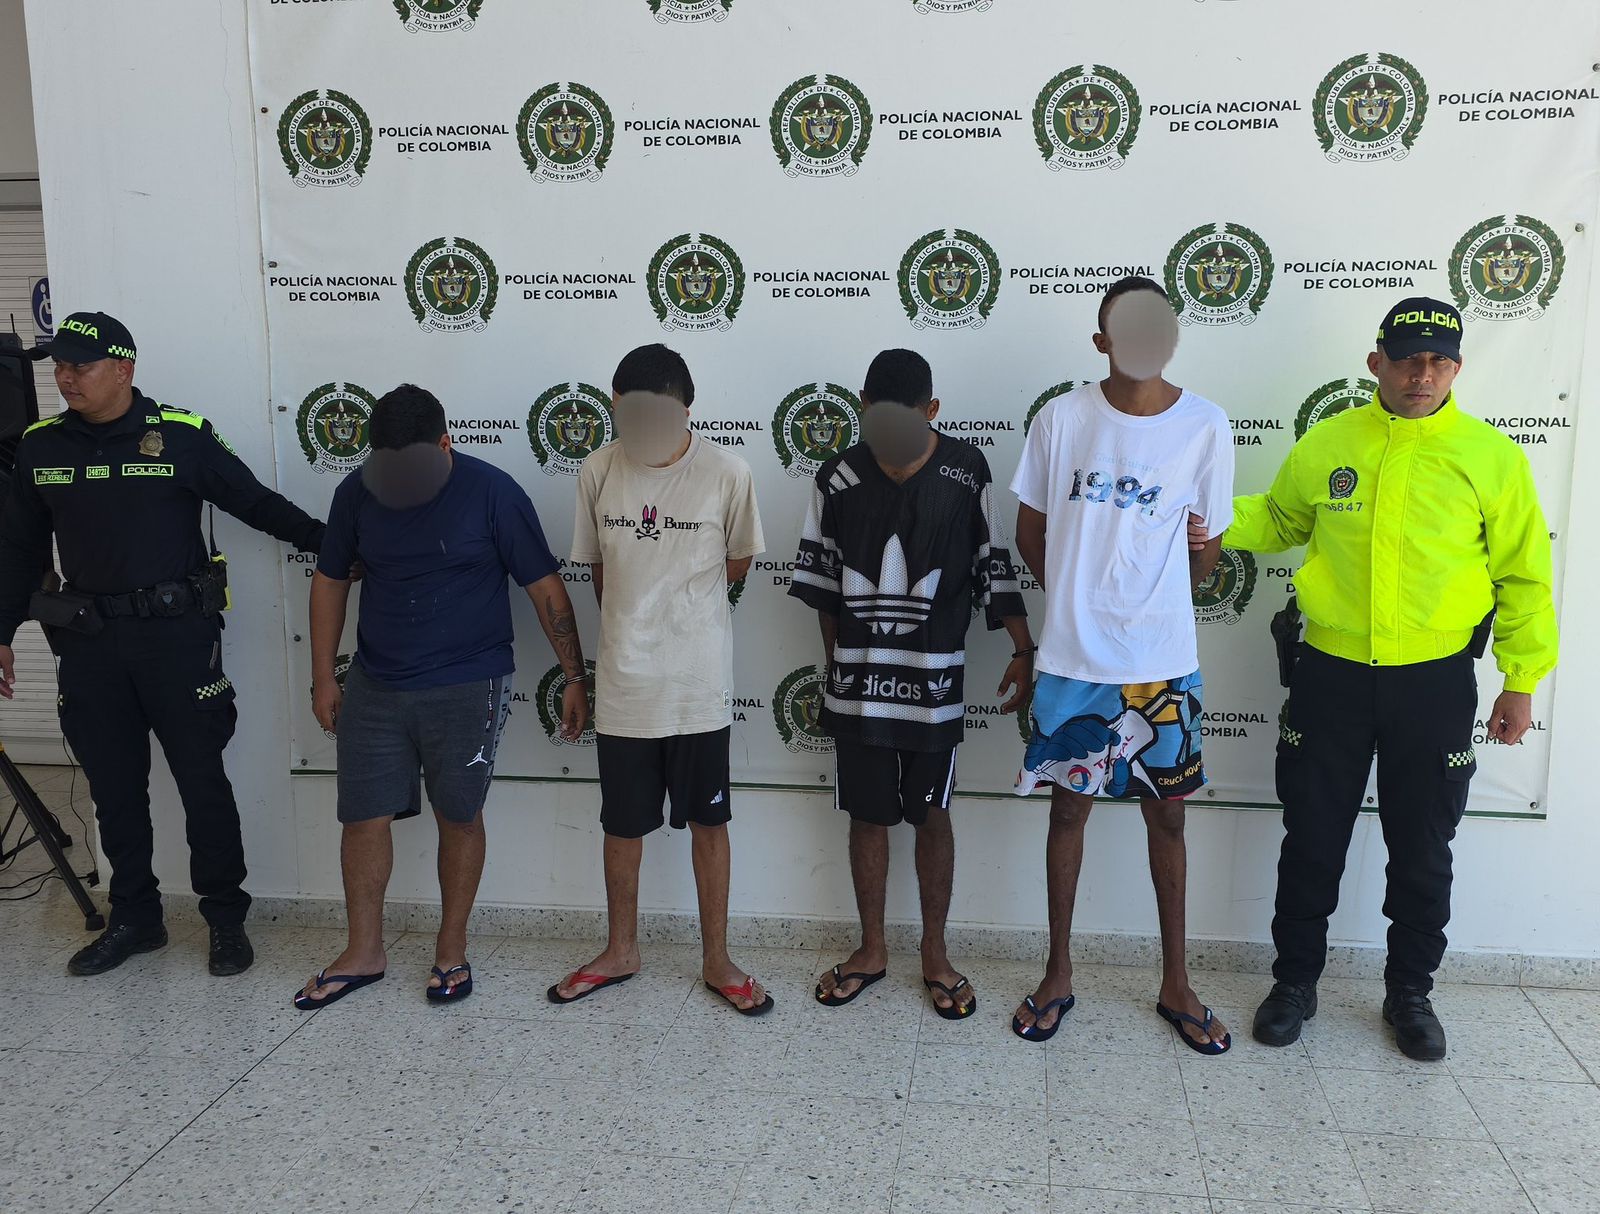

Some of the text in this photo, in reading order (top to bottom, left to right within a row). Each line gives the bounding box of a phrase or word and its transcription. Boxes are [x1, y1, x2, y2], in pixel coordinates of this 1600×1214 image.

[1389, 69, 1414, 112] COLOMBIA
[1438, 88, 1599, 105] POLICÍA NACIONAL
[1103, 81, 1128, 123] COLOMBIA
[1150, 100, 1301, 116] POLICÍA NACIONAL
[578, 98, 602, 137] COLOMBIA
[836, 90, 860, 131] COLOMBIA
[880, 110, 1023, 124] POLICÍA NACIONAL
[1459, 107, 1575, 122] DE COLOMBIA
[337, 104, 361, 143] COLOMBIA
[379, 123, 509, 137] POLICÍA NACIONAL
[624, 117, 760, 131] POLICÍA NACIONAL
[1170, 118, 1279, 132] DE COLOMBIA
[643, 134, 741, 147] DE COLOMBIA
[899, 127, 1002, 140] DE COLOMBIA
[1368, 120, 1409, 149] NACIONAL
[398, 141, 491, 153] DE COLOMBIA
[1086, 130, 1124, 158] NACIONAL
[566, 144, 600, 171] NACIONAL
[821, 138, 856, 165] NACIONAL
[1367, 146, 1397, 159] PATRIA
[327, 150, 359, 176] NACIONAL
[821, 163, 847, 175] PATRIA
[1085, 156, 1113, 168] PATRIA
[566, 168, 592, 180] PATRIA
[1526, 231, 1550, 273] COLOMBIA
[964, 244, 988, 285] COLOMBIA
[1236, 239, 1260, 280] COLOMBIA
[1284, 259, 1437, 273] POLICÍA NACIONAL
[464, 252, 487, 290] COLOMBIA
[709, 249, 733, 288] COLOMBIA
[753, 269, 890, 282] POLICÍA NACIONAL
[1010, 265, 1155, 278] POLICÍA NACIONAL
[270, 274, 397, 287] POLICÍA NACIONAL
[505, 272, 636, 284] POLICÍA NACIONAL
[1304, 277, 1414, 289] DE COLOMBIA
[523, 289, 618, 300] DE COLOMBIA
[772, 287, 870, 298] DE COLOMBIA
[1029, 283, 1108, 294] DE COLOM
[1503, 280, 1545, 308] NACIONAL
[289, 291, 380, 301] DE COLOMBIA
[1217, 286, 1256, 314] NACIONAL
[453, 296, 484, 321] NACIONAL
[696, 294, 730, 320] NACIONAL
[948, 291, 985, 318] NACIONAL
[1216, 311, 1244, 323] PATRIA
[1502, 306, 1533, 318] PATRIA
[696, 318, 722, 329] PATRIA
[948, 316, 975, 327] PATRIA
[1393, 310, 1460, 331] POLICÍA
[448, 420, 520, 429] NACIONAL
[690, 421, 763, 431] NACIONAL
[938, 421, 1015, 431] NACIONAL
[451, 435, 502, 444] LOMBIA
[127, 466, 167, 474] POLICÍA
[1069, 469, 1163, 516] 1994
[604, 515, 703, 532] Psycho Bunny
[287, 554, 316, 563] POLI
[755, 561, 795, 571] POLIC
[773, 576, 791, 585] DE
[1021, 580, 1039, 590] DE
[862, 674, 922, 700] didas
[1201, 712, 1269, 723] ACIONAL
[1200, 727, 1248, 737] OMBIA
